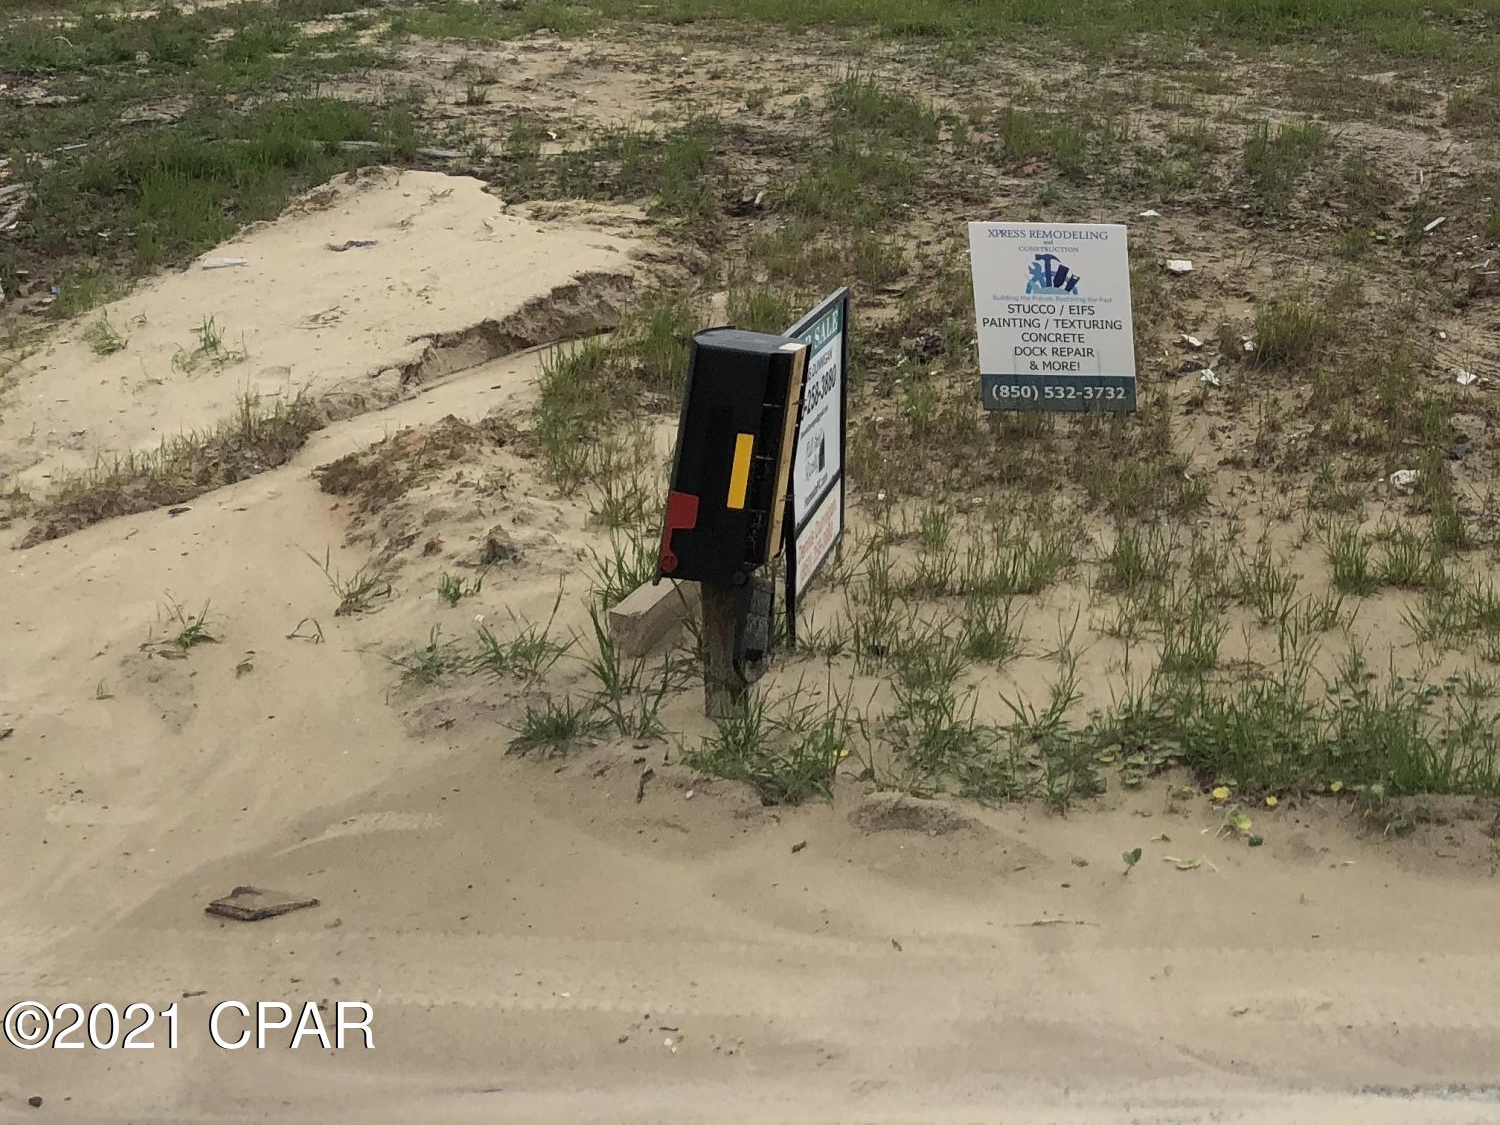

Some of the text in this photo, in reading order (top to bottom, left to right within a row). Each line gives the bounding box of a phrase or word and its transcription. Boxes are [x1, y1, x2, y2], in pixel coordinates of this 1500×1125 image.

[988, 229, 1108, 240] XPRESS REMODELING
[1007, 304, 1095, 316] STUCCO / EIFS
[814, 309, 839, 349] SALE
[982, 318, 1122, 330] PAINTING / TEXTURING
[1021, 332, 1085, 343] CONCRETE
[1014, 346, 1094, 357] DOCK REPAIR
[1029, 360, 1080, 371] & MORE!
[992, 384, 1127, 401] (850) 532-3732
